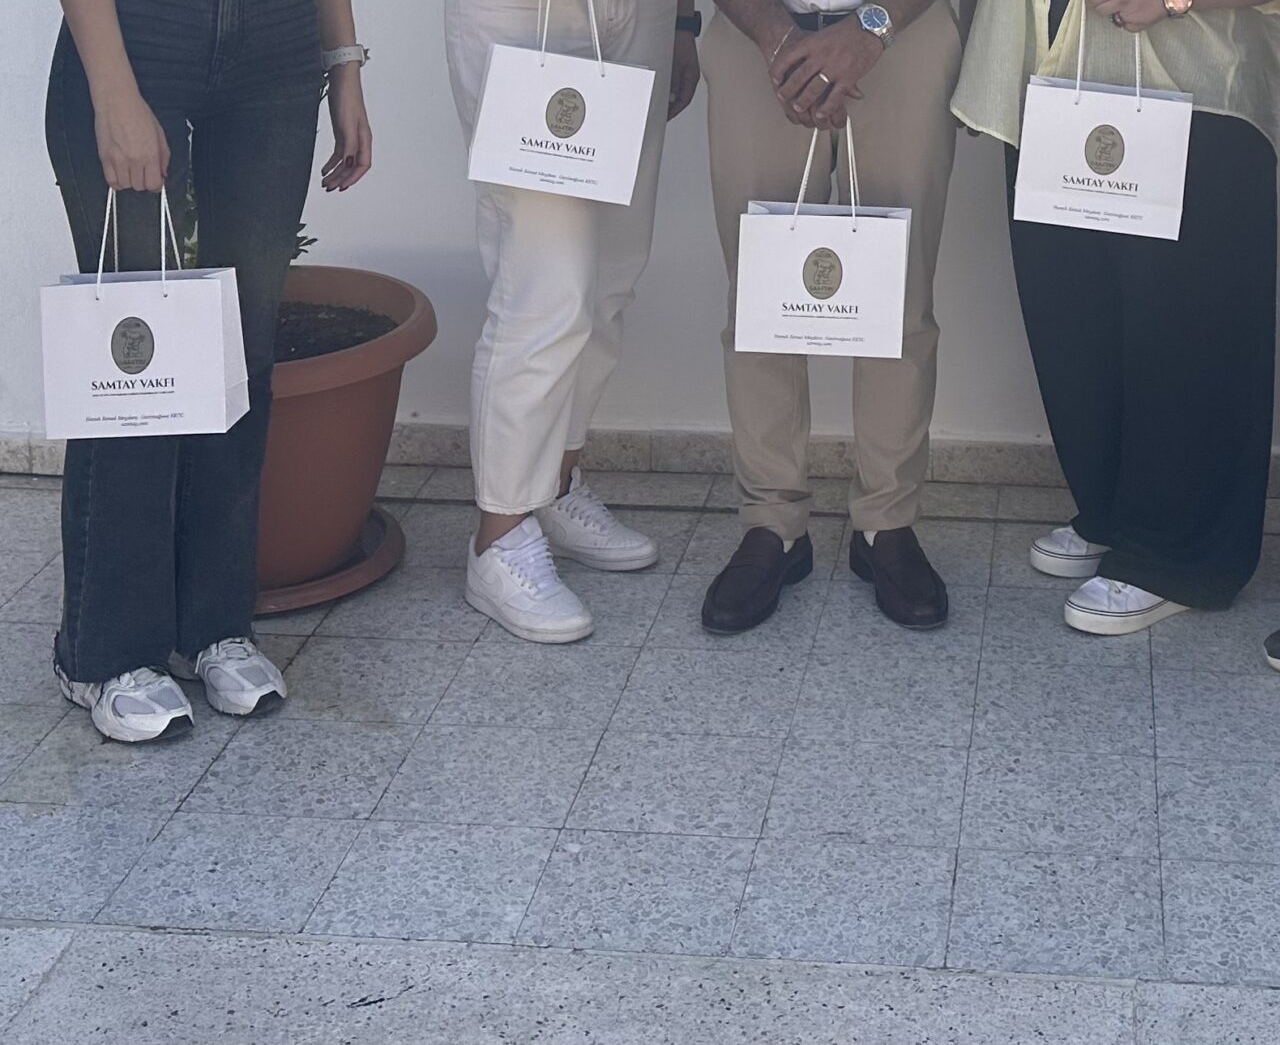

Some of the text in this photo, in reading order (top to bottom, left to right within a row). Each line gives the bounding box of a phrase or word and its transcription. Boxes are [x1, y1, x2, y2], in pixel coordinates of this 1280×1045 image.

[521, 137, 563, 152] SAMTAY
[565, 143, 596, 157] VAKFI
[1062, 174, 1105, 188] SAMTAY
[1107, 181, 1138, 192] VAKFI
[782, 302, 859, 315] SAMTAY VAKFI
[91, 377, 175, 391] SAMTAY VAKFI
